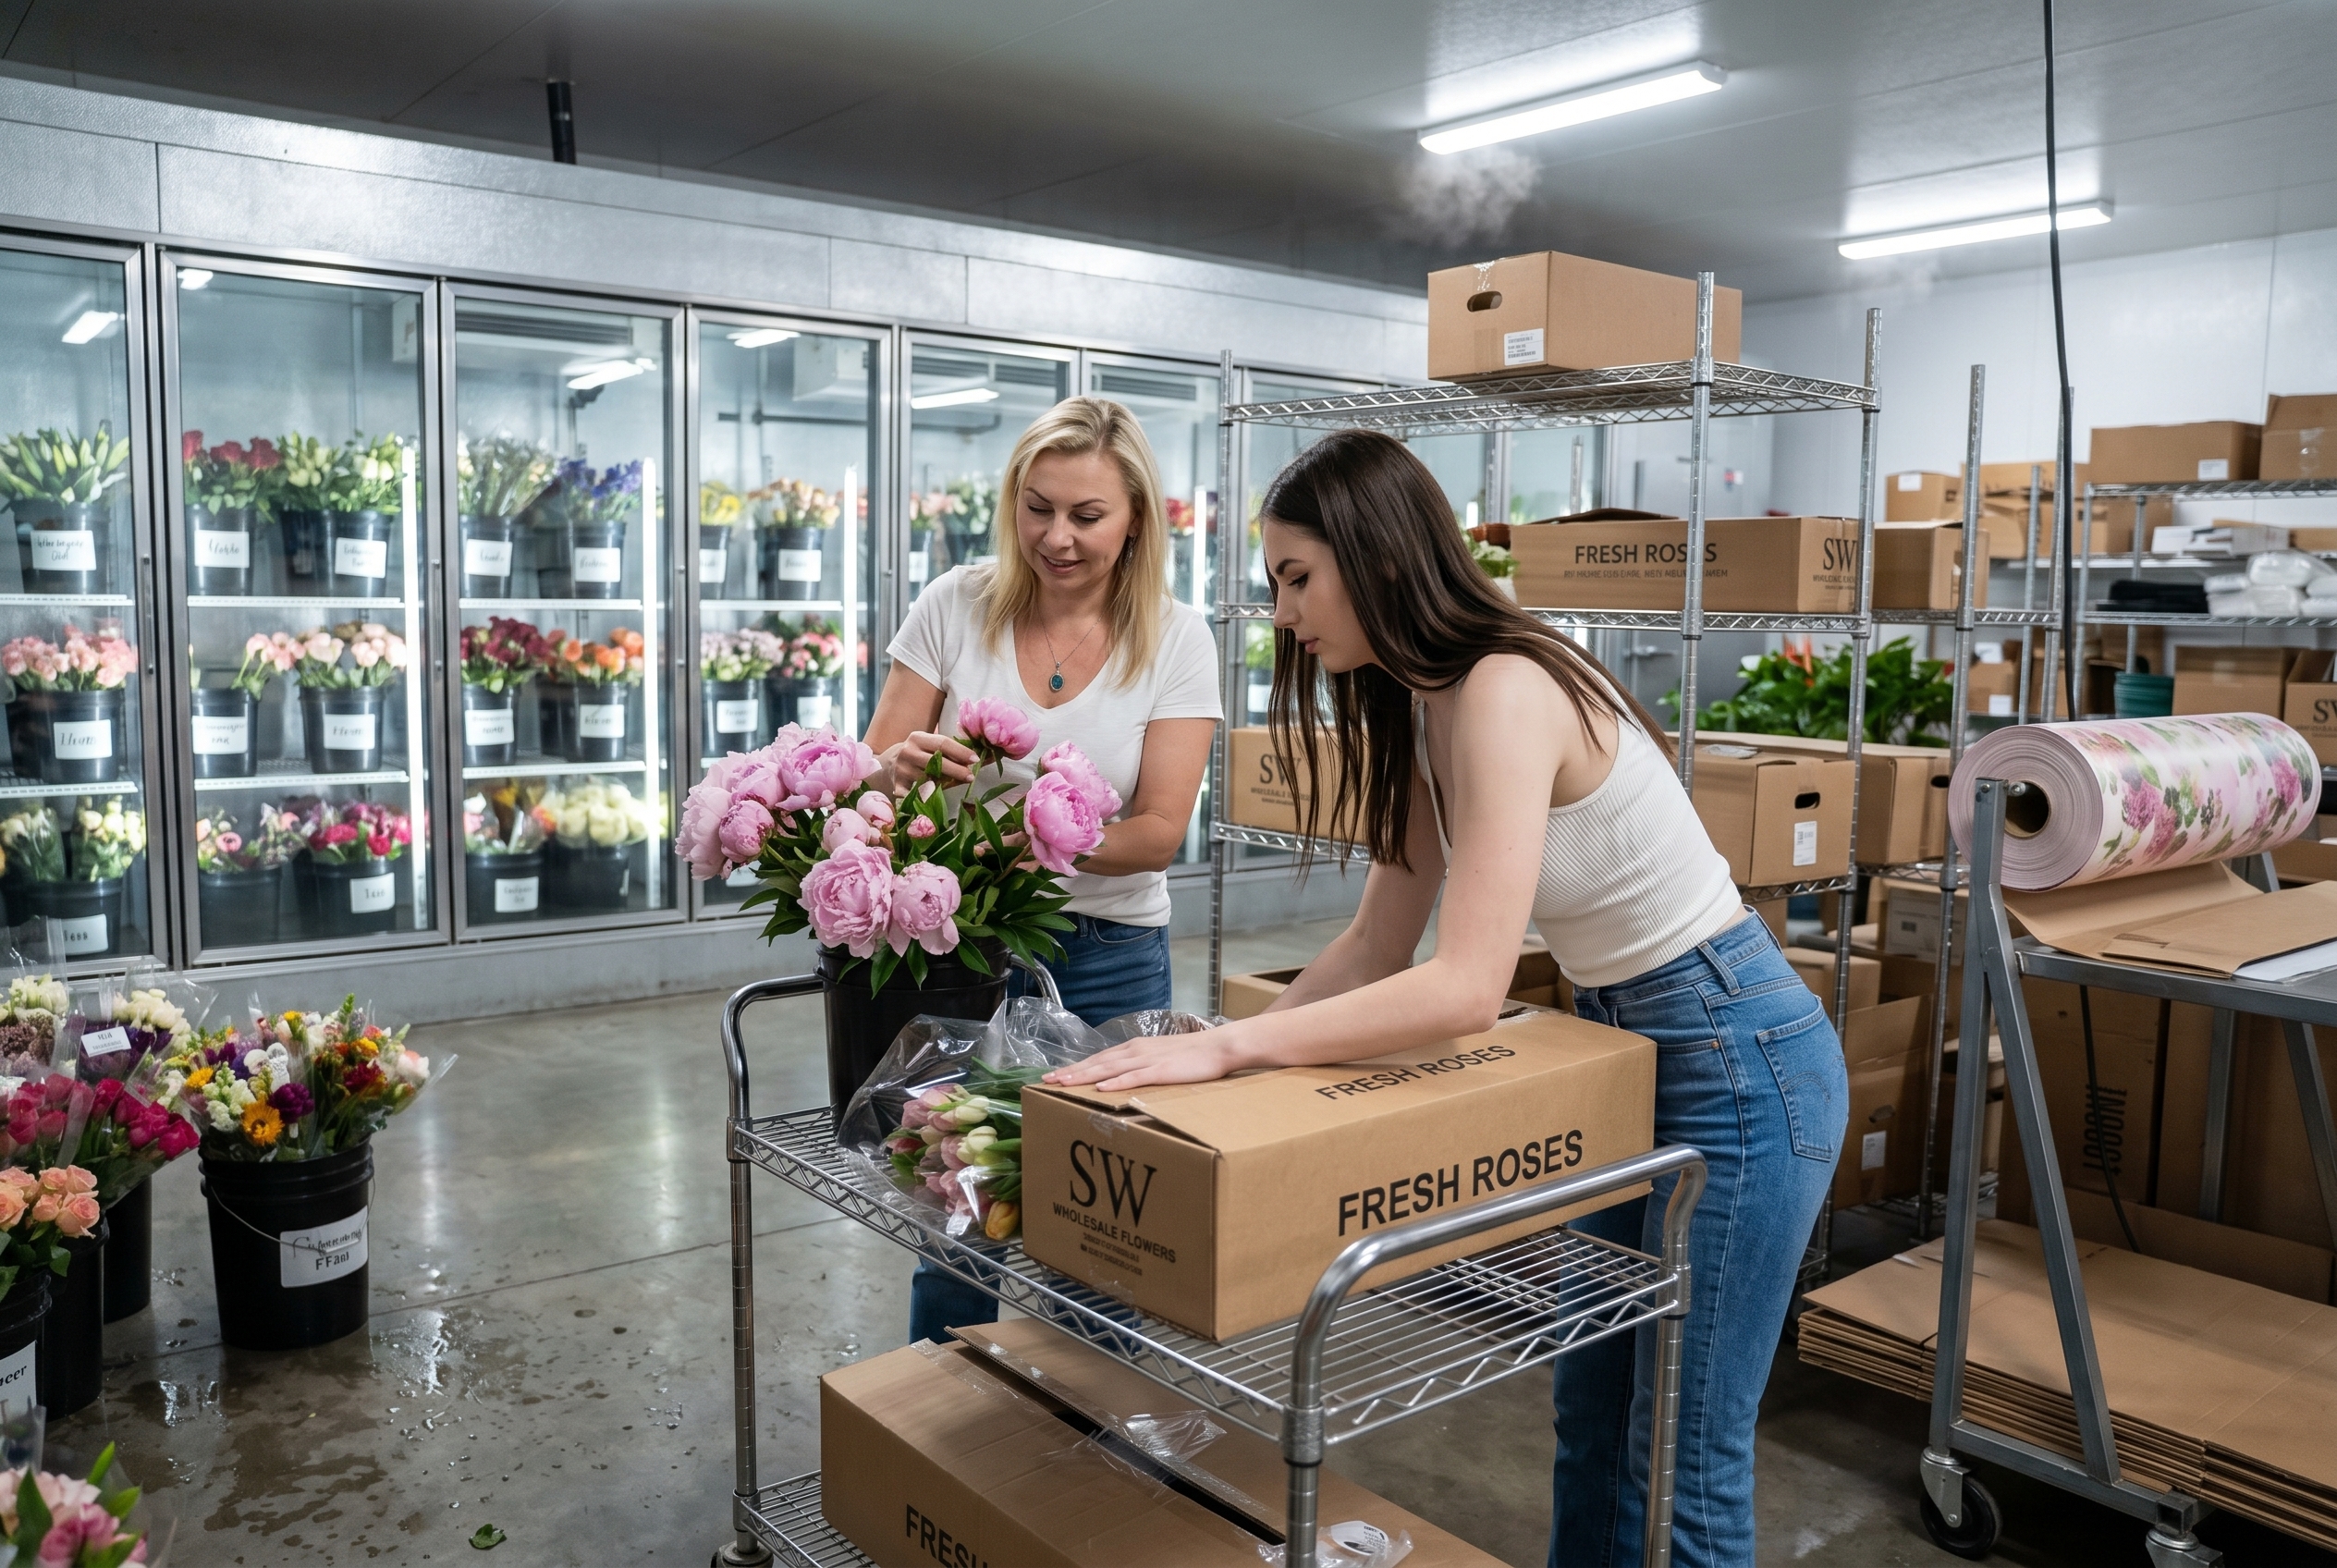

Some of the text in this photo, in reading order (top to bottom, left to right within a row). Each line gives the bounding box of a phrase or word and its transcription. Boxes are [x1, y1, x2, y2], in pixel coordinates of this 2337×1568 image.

[1575, 543, 1718, 564] FRESH ROSS
[1823, 537, 1857, 572] SW
[1315, 1046, 1516, 1100] FRESH ROSES
[1070, 1139, 1158, 1229] SW
[1339, 1129, 1584, 1237] FRESH ROSES
[1053, 1202, 1119, 1240] WHOLESALE
[1121, 1230, 1177, 1264] FLOWERS
